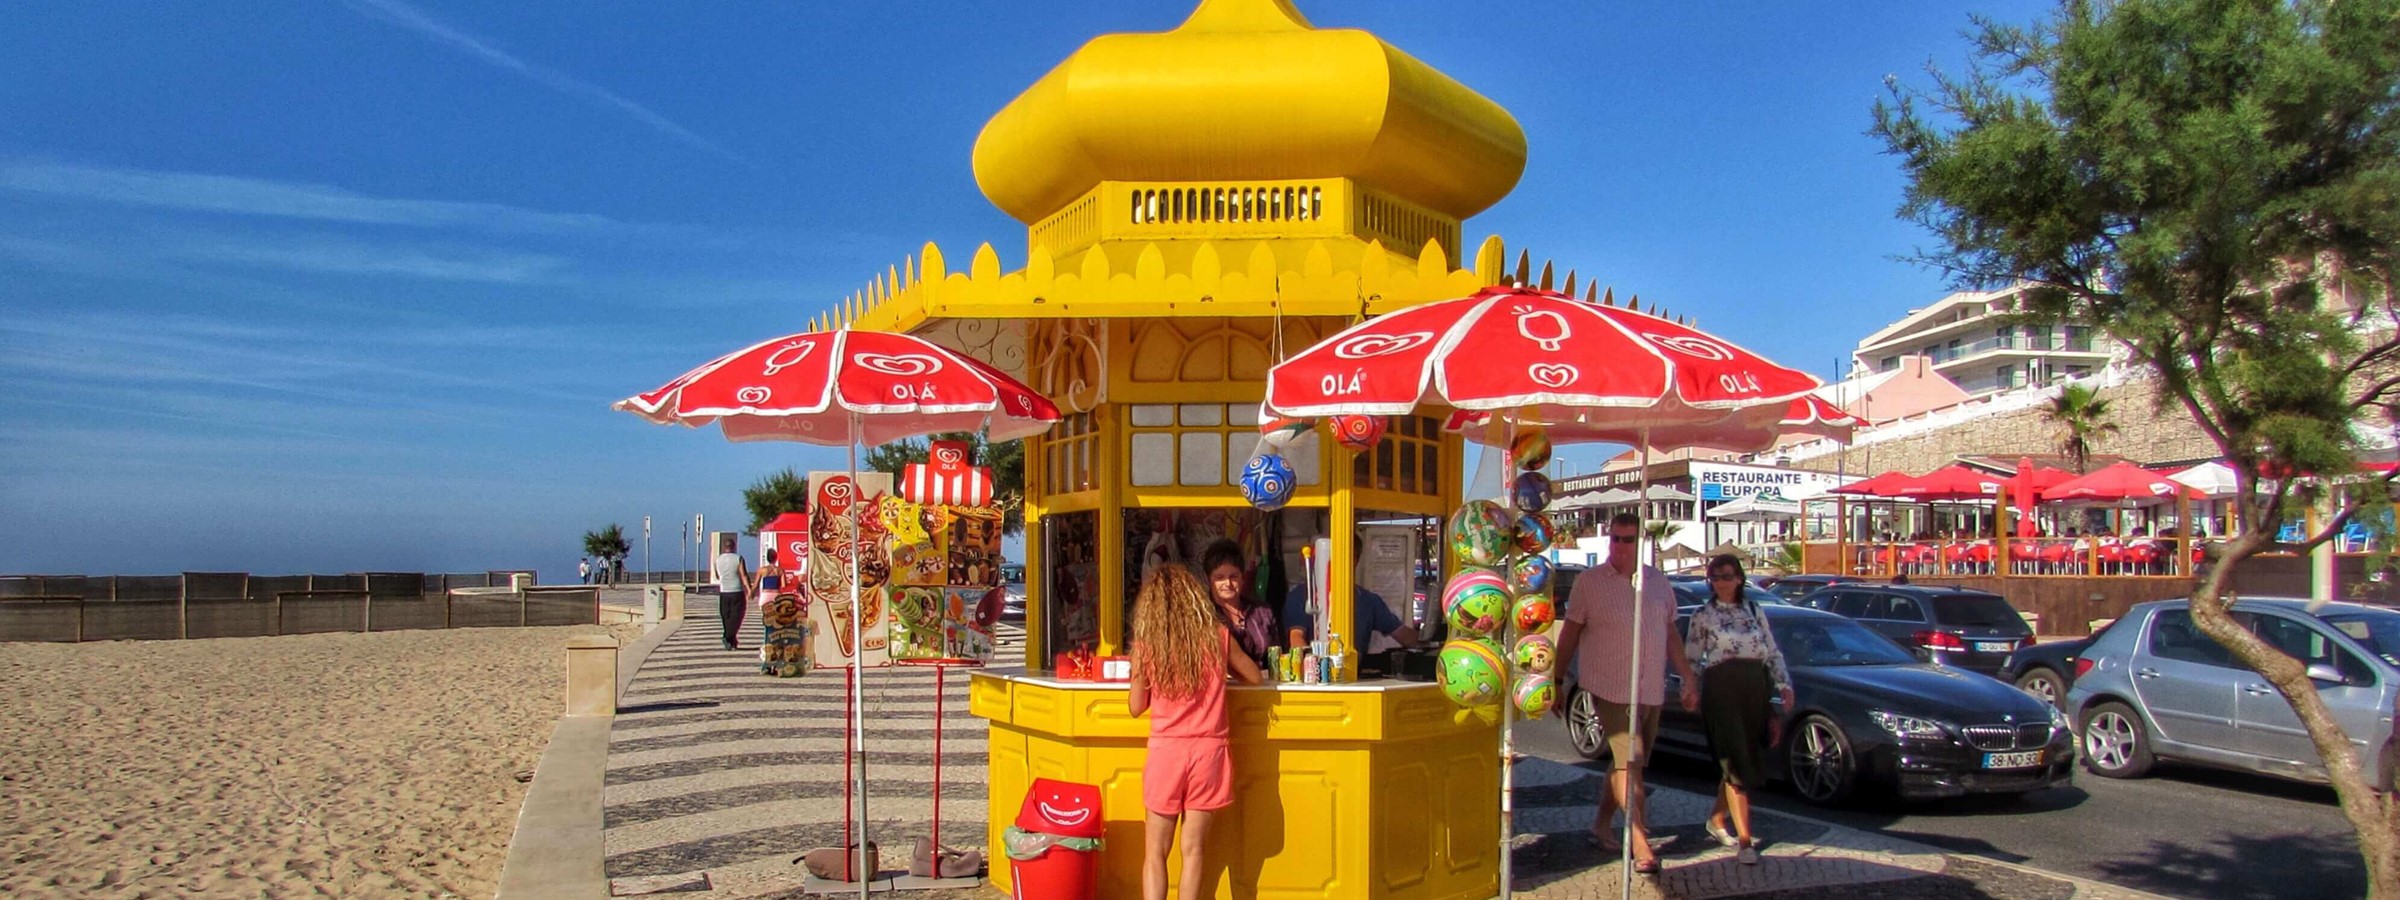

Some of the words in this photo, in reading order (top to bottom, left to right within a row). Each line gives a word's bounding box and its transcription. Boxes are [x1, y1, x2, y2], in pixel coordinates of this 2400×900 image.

[1563, 475, 1609, 492] RESTAURANTE
[1702, 472, 1802, 485] RESTAURANTE
[1722, 485, 1782, 497] EUROPA
